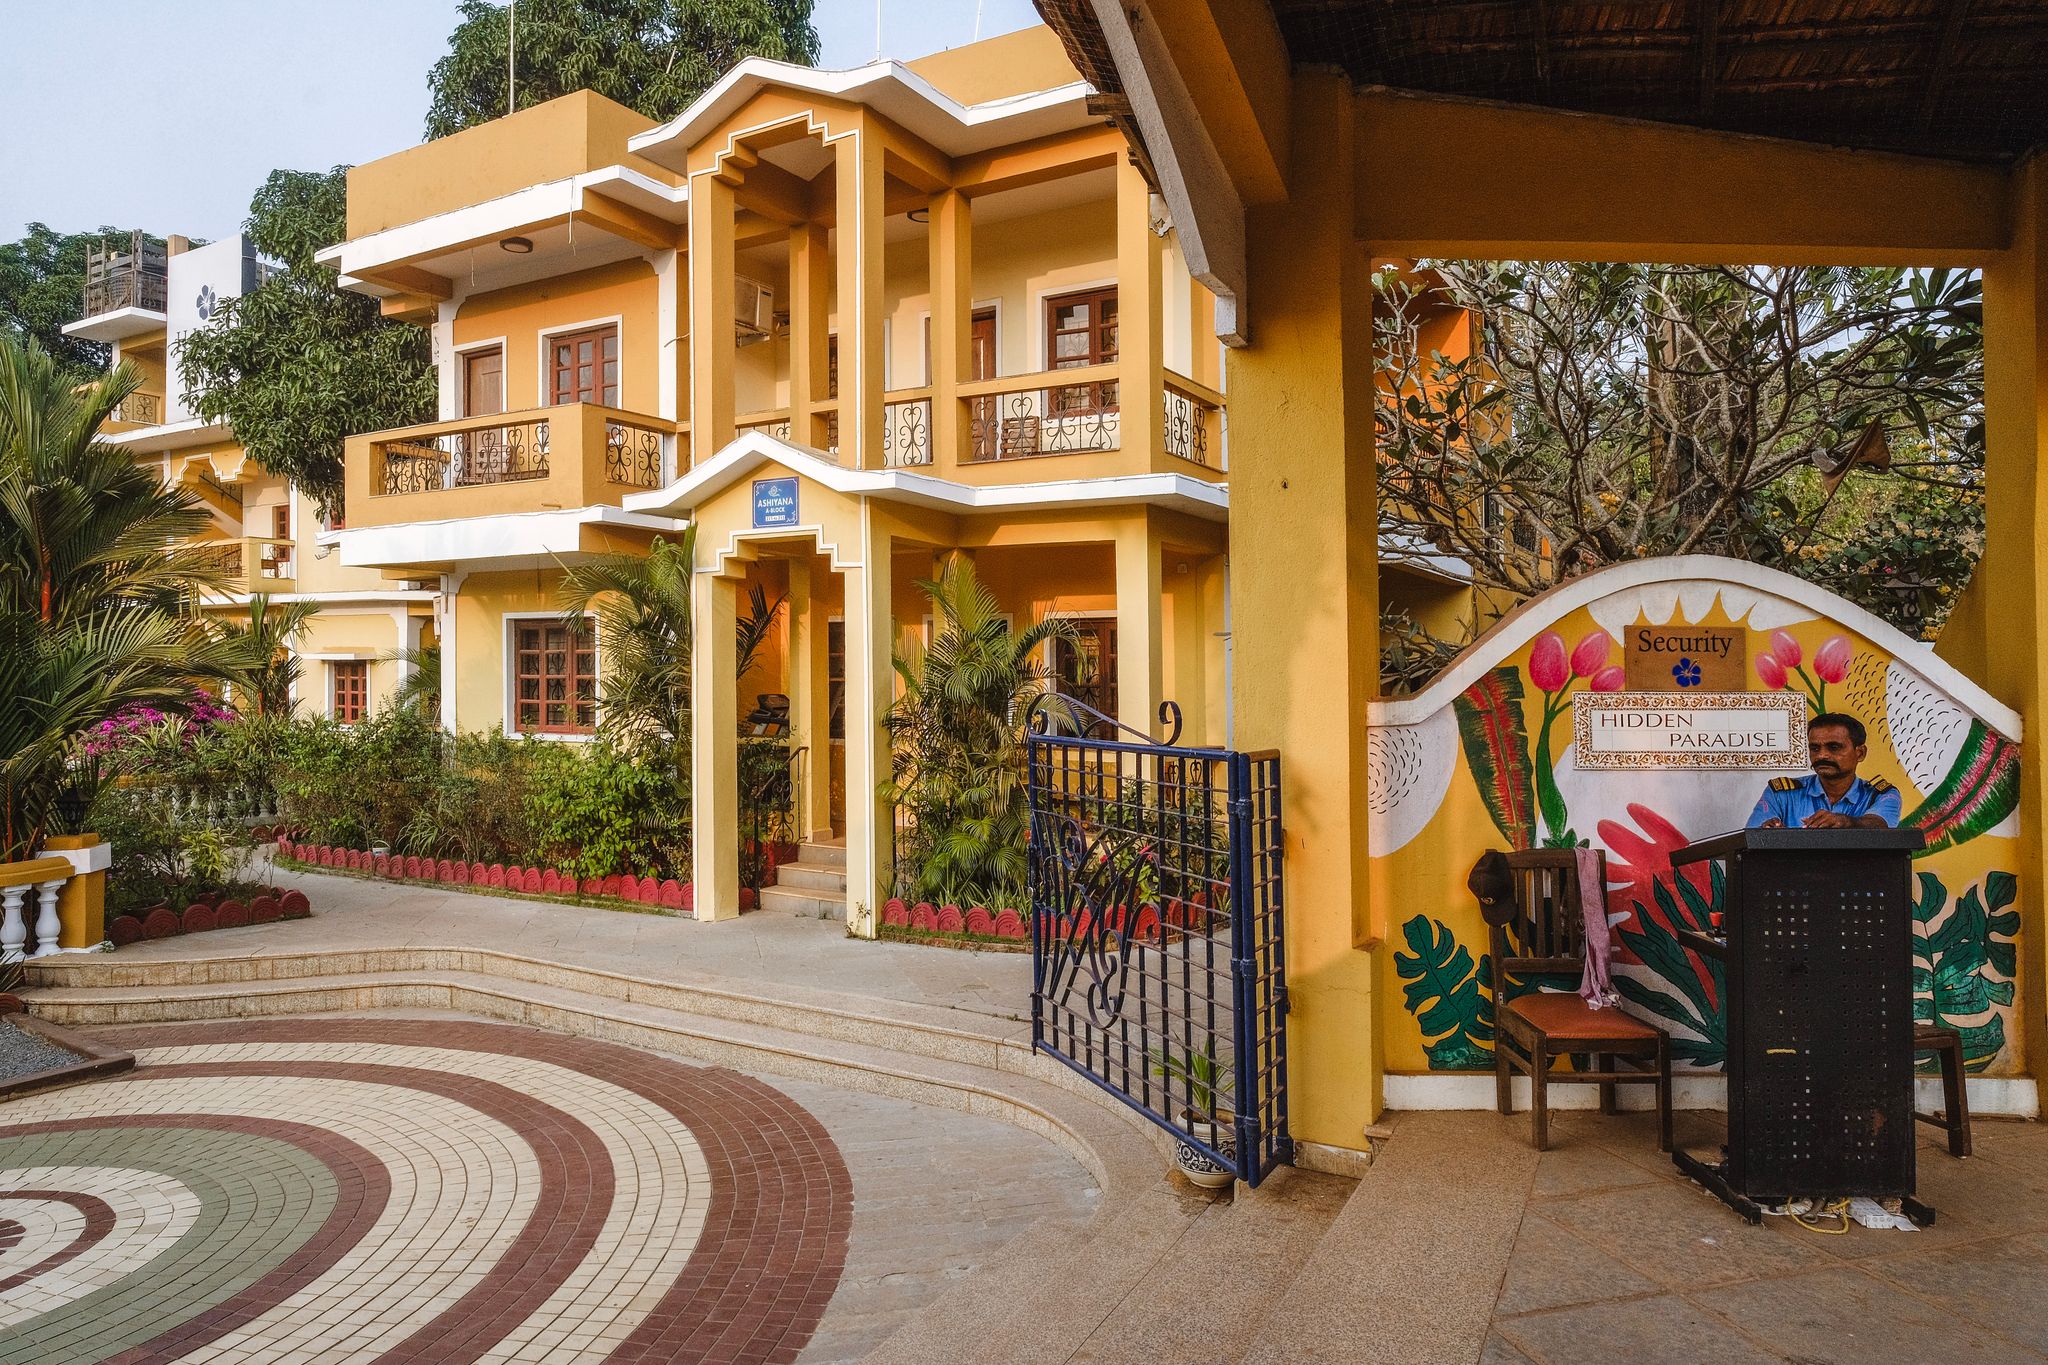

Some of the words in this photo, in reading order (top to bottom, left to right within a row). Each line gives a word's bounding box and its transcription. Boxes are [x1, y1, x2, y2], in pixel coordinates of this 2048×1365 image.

[758, 497, 793, 508] ASHIYANA
[1638, 629, 1733, 658] Security
[1601, 713, 1692, 728] HIDDEN
[1670, 733, 1777, 747] PARADISE
